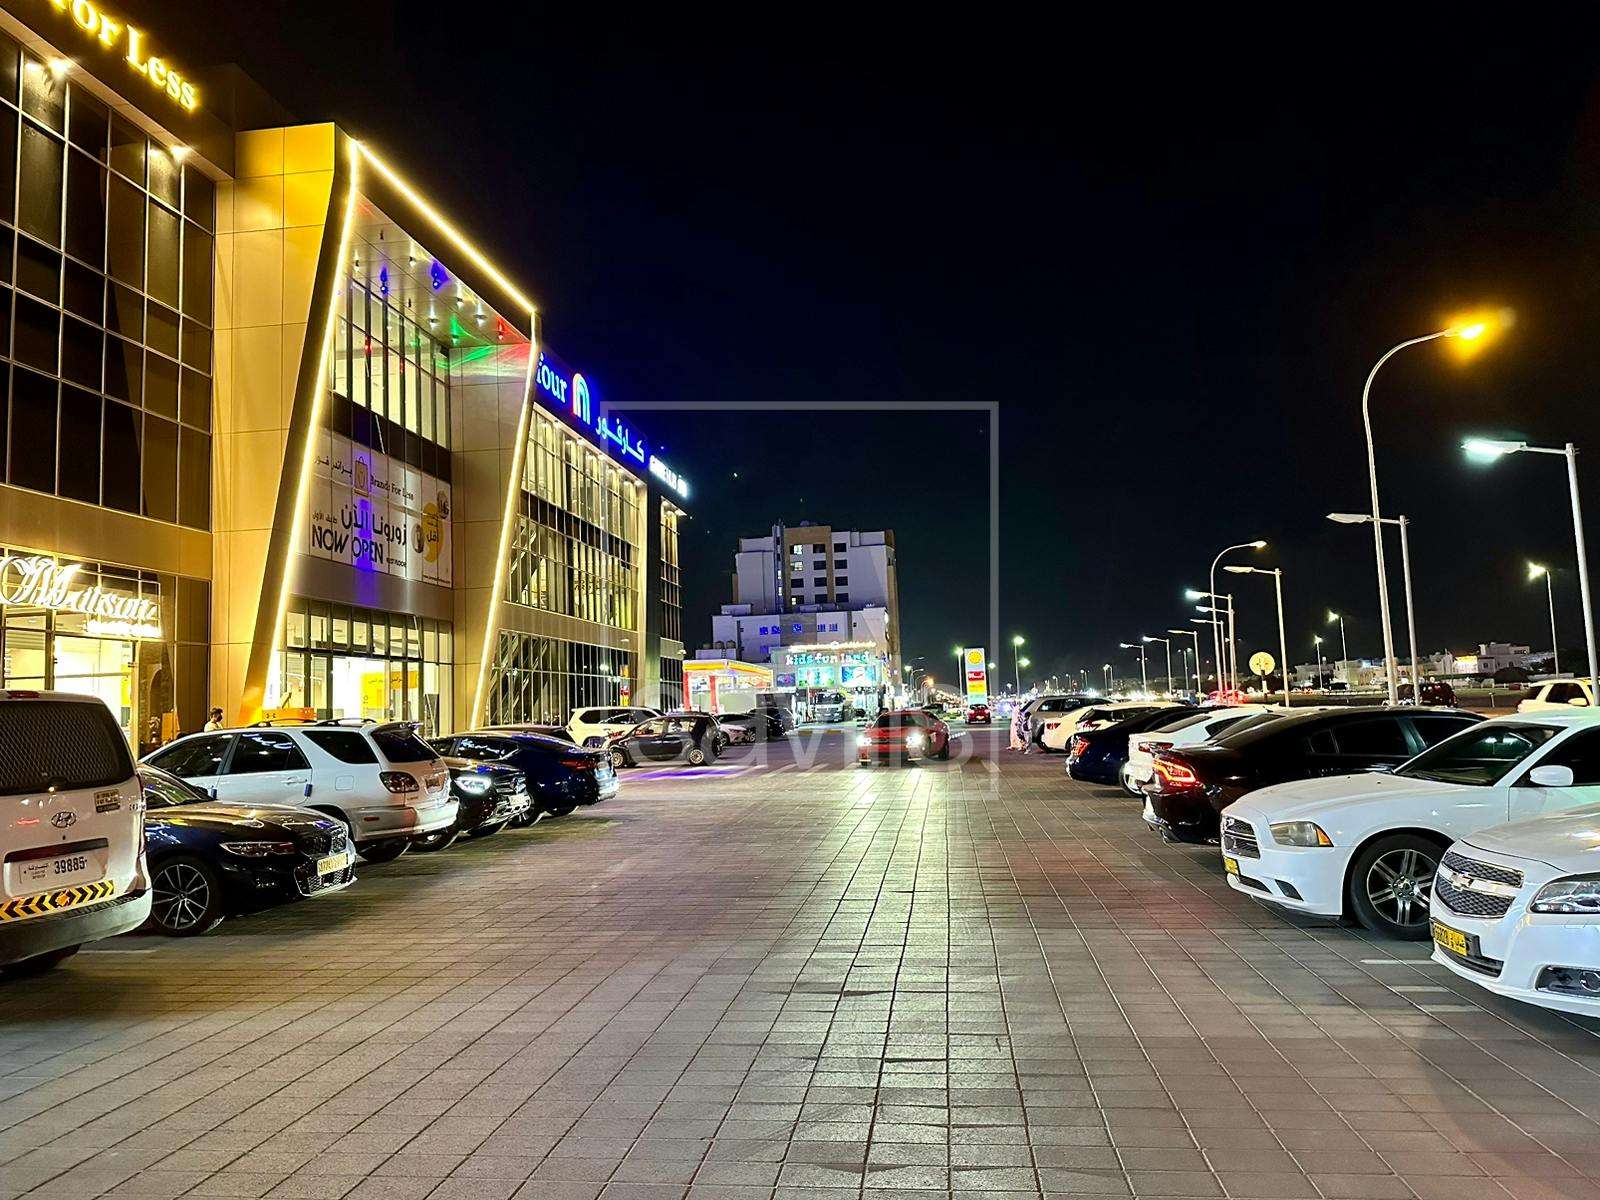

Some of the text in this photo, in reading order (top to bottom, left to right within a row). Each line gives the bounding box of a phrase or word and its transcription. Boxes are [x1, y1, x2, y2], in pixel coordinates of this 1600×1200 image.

[54, 0, 199, 112] or Less
[391, 482, 402, 496] For
[372, 513, 407, 546] زورونا
[312, 524, 384, 564] NOW OPEN
[785, 650, 870, 666] kids fun land
[54, 856, 84, 875] 39885
